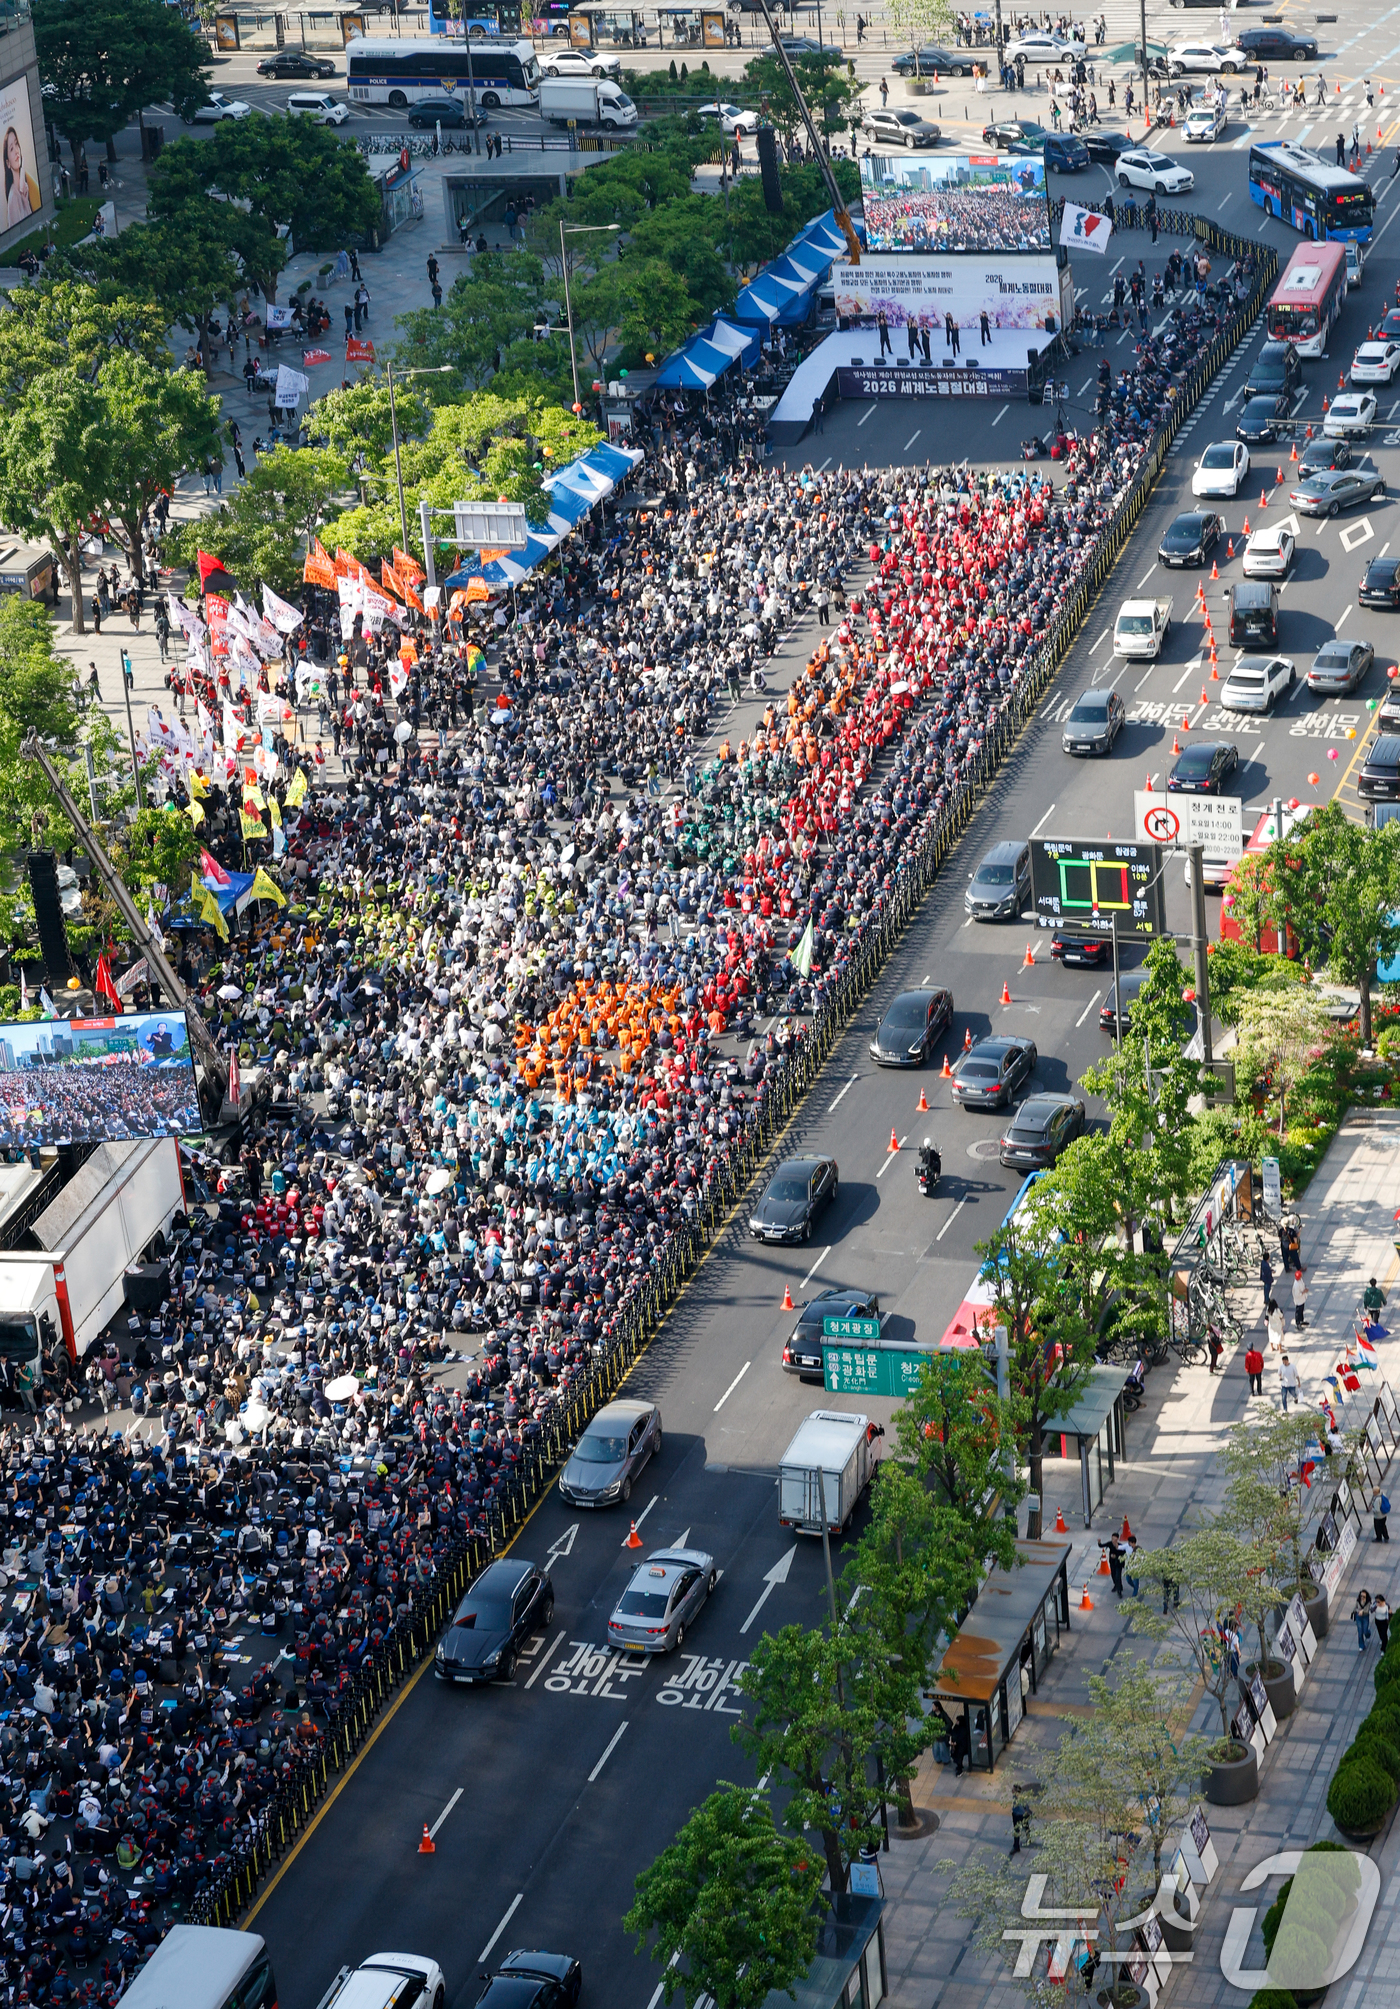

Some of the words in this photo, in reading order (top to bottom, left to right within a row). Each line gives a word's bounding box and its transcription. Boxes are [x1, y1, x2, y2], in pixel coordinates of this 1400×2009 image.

[985, 274, 1003, 284] 2026
[1000, 282, 1053, 294] 세계노동절대회
[863, 380, 897, 393] 2026
[900, 381, 987, 394] 세계노동절대회
[1288, 711, 1360, 740] 광화문
[1191, 802, 1238, 815] 청계천로
[1191, 819, 1210, 828] 토요일
[1211, 820, 1232, 829] 14:00
[1218, 832, 1240, 843] 22:00
[1043, 842, 1073, 853] 독립문역
[1047, 851, 1060, 860] 7분
[1081, 851, 1104, 861] 광화문
[1132, 872, 1148, 882] 10분
[1038, 896, 1060, 906] 서대문
[1136, 921, 1153, 933] 서행
[829, 1320, 874, 1335] 청계광장
[841, 1352, 878, 1367] 독립문
[842, 1364, 878, 1379] 광화문
[843, 1376, 867, 1386] 光化門
[544, 1641, 653, 1700] 광화문
